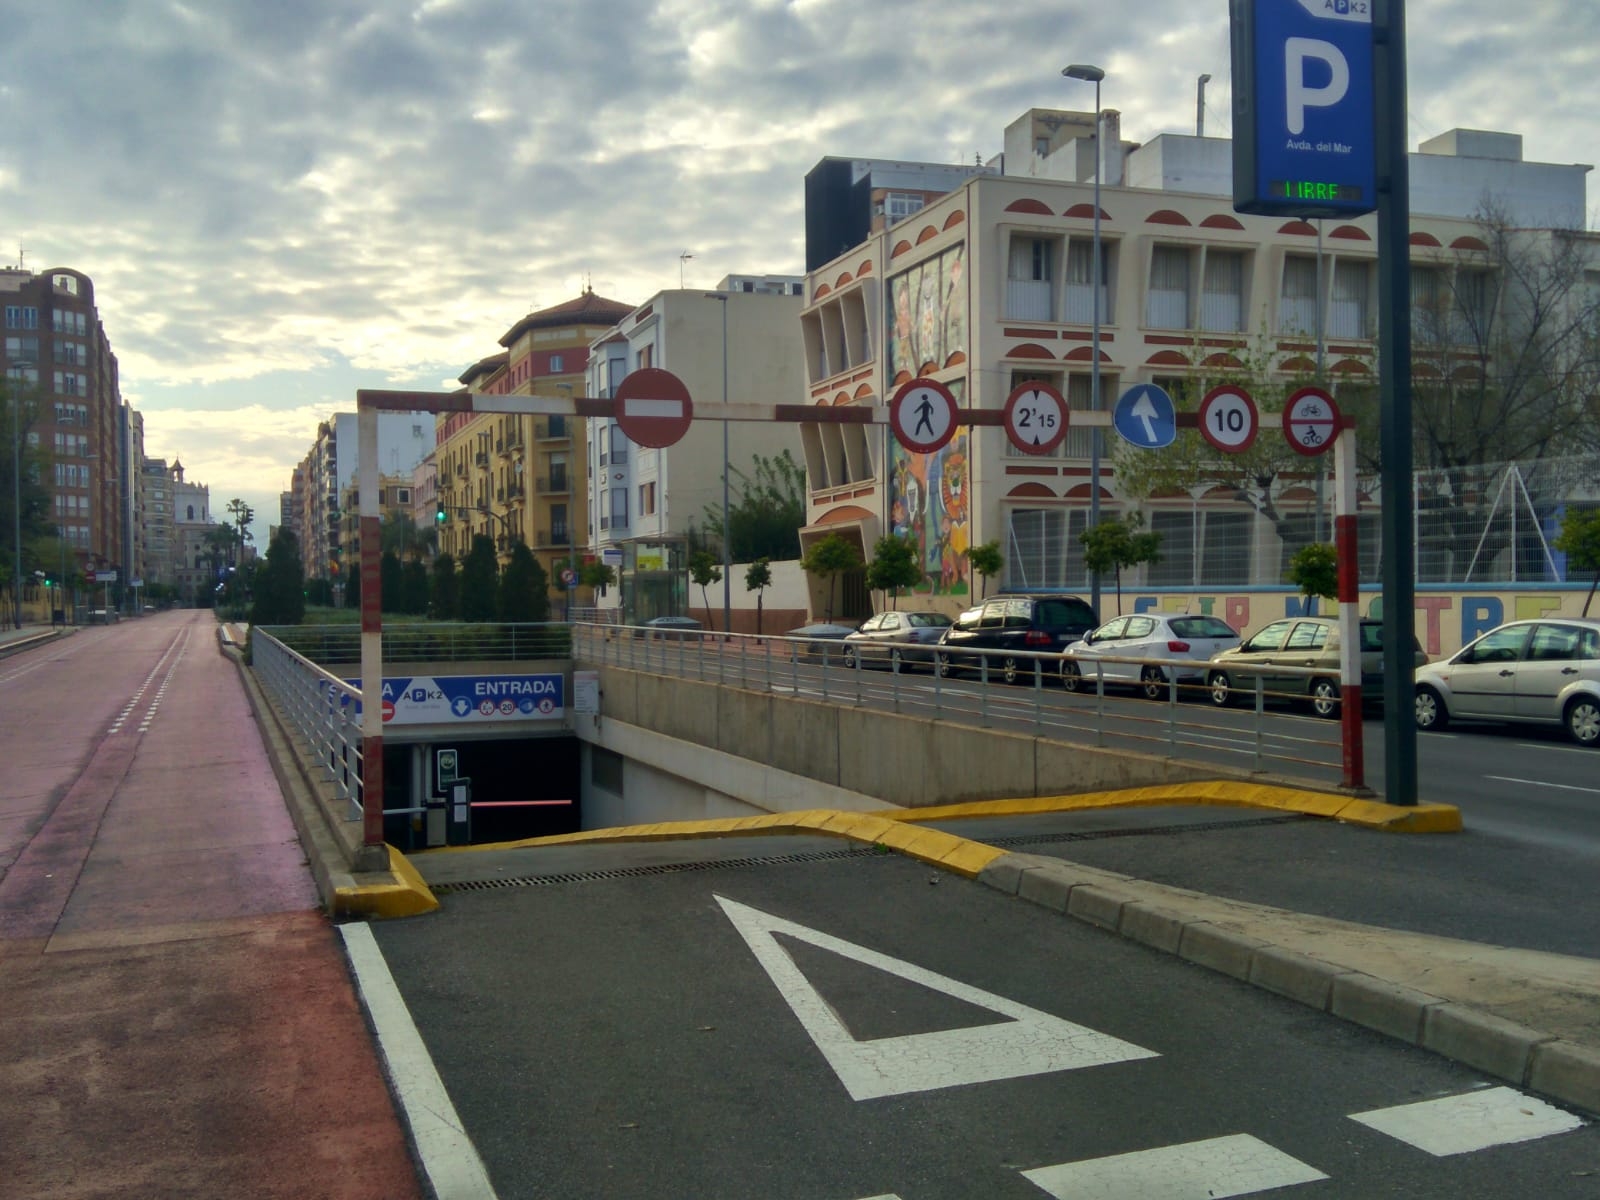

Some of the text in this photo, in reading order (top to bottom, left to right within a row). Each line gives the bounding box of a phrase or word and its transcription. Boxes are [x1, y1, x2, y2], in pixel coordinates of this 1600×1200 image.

[1285, 36, 1350, 135] P
[1286, 139, 1353, 153] Avda. del Mar
[1215, 408, 1244, 432] 10
[475, 680, 556, 695] ENTRADA
[502, 703, 512, 711] 20
